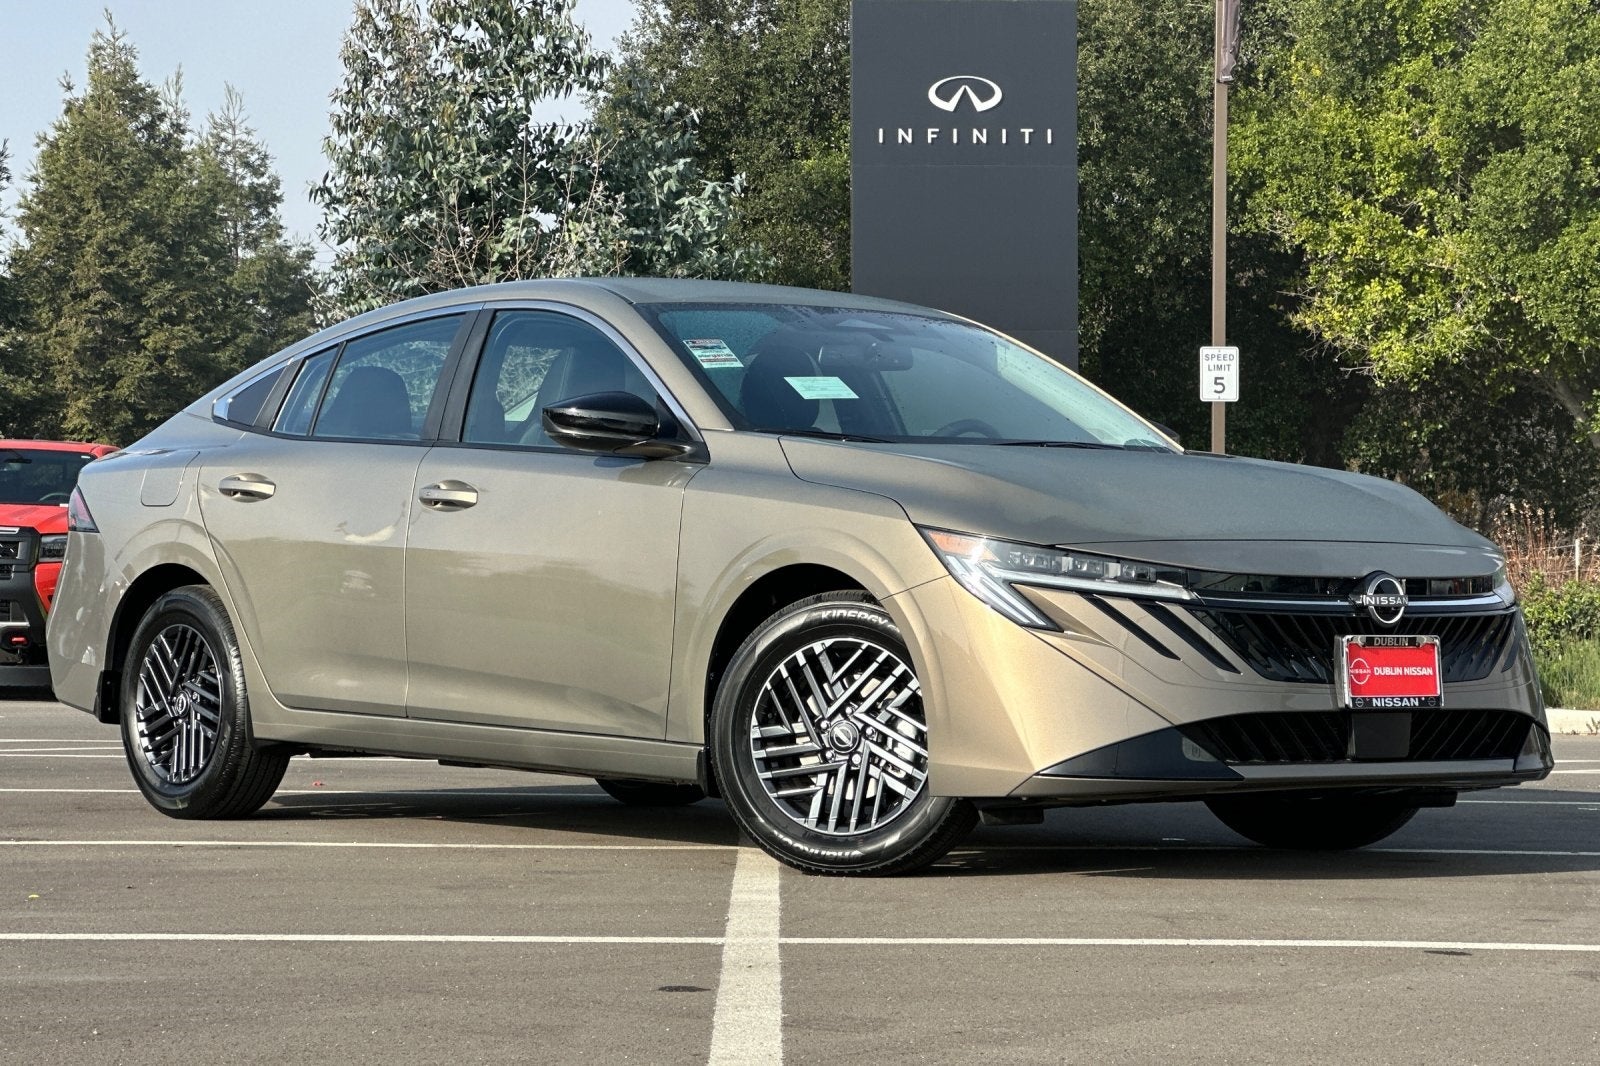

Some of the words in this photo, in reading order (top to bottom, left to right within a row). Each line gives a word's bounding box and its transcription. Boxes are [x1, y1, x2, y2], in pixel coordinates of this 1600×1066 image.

[878, 128, 1053, 144] INFINITI
[1204, 353, 1235, 361] SPEED
[1207, 364, 1231, 372] LIMIT
[1213, 376, 1226, 394] 5
[1366, 596, 1408, 605] NISSAN
[1373, 637, 1409, 646] DUBLIN
[1373, 667, 1403, 676] DUBLIN
[1404, 667, 1433, 676] NISSAN
[1372, 697, 1419, 707] NISSAN
